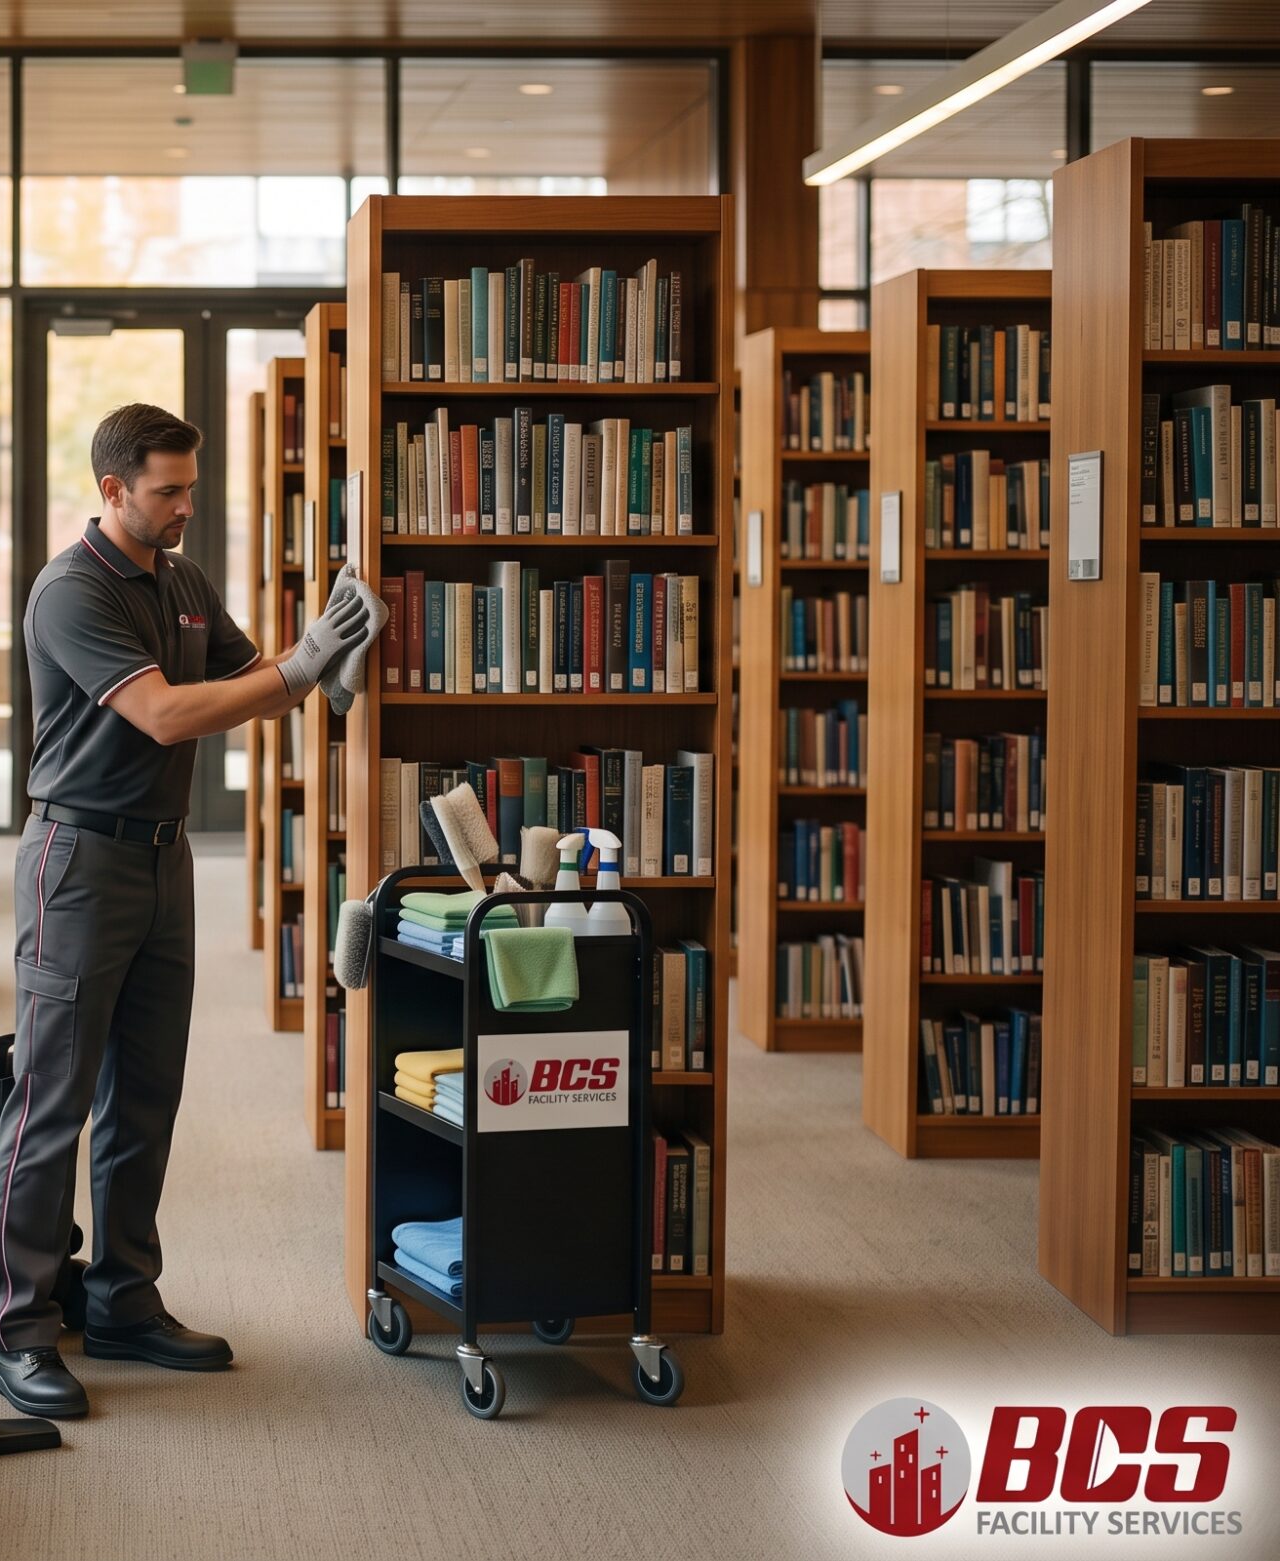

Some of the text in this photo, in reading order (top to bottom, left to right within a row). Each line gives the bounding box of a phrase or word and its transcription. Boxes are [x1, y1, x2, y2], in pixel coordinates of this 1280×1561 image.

[529, 1058, 620, 1092] BCS
[528, 1092, 617, 1104] FACILITY SERVICES
